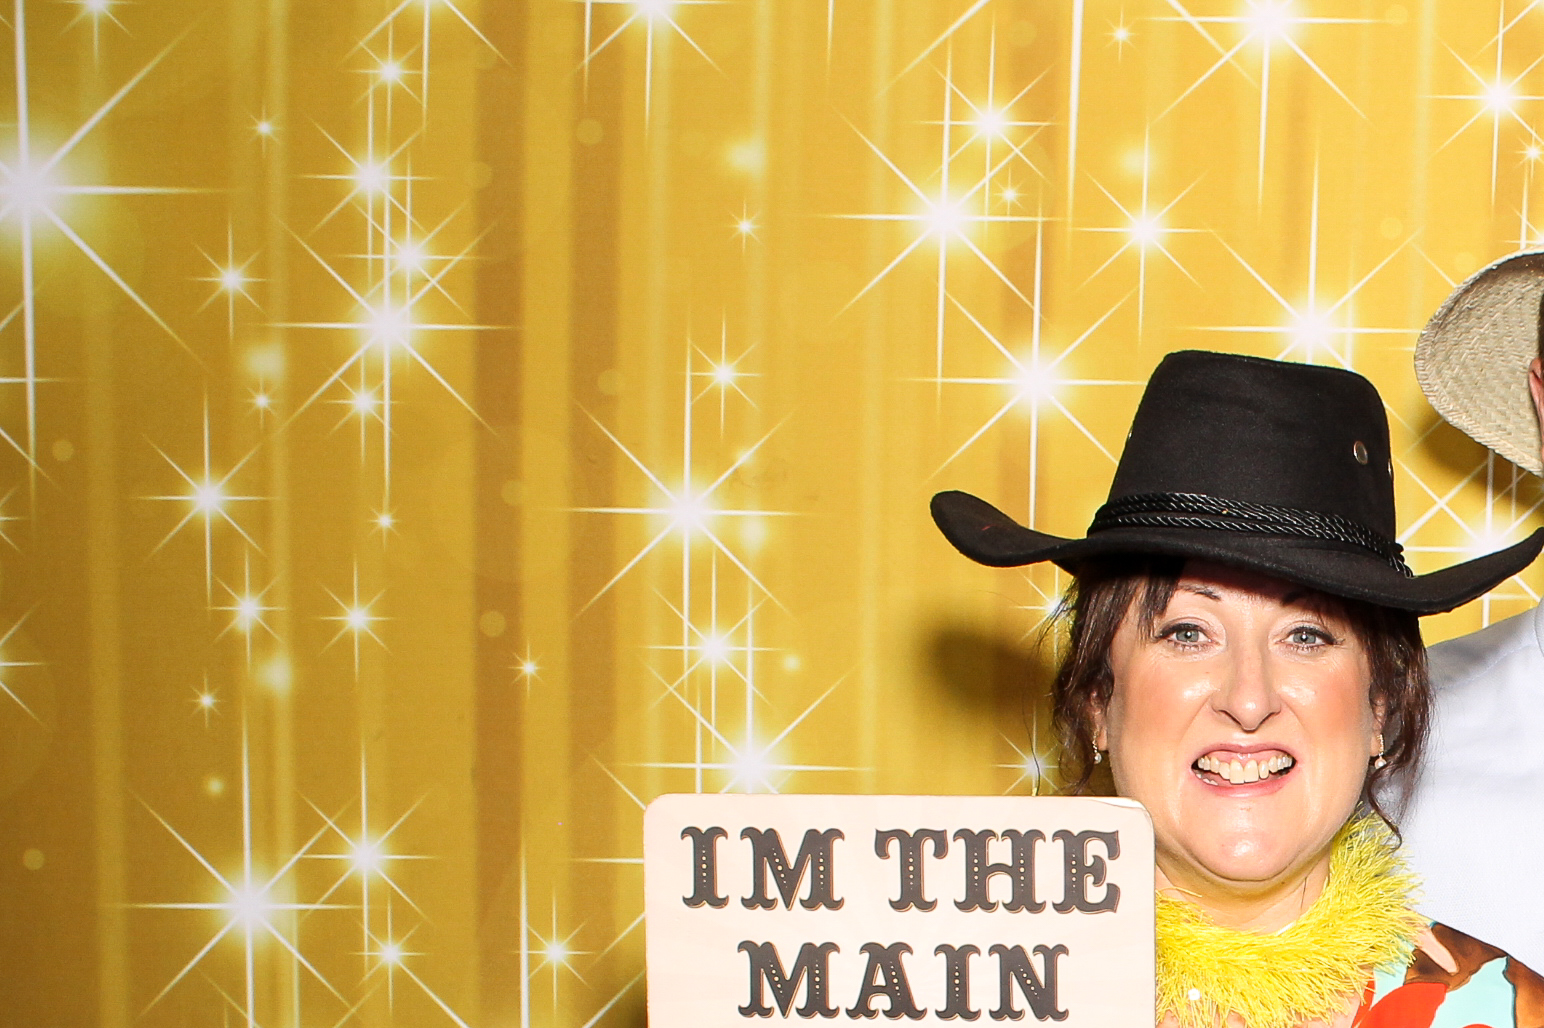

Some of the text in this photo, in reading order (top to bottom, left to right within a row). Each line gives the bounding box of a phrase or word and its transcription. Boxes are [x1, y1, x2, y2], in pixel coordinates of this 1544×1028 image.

[680, 826, 1121, 914] IM THE
[737, 940, 1069, 1022] MAIN
